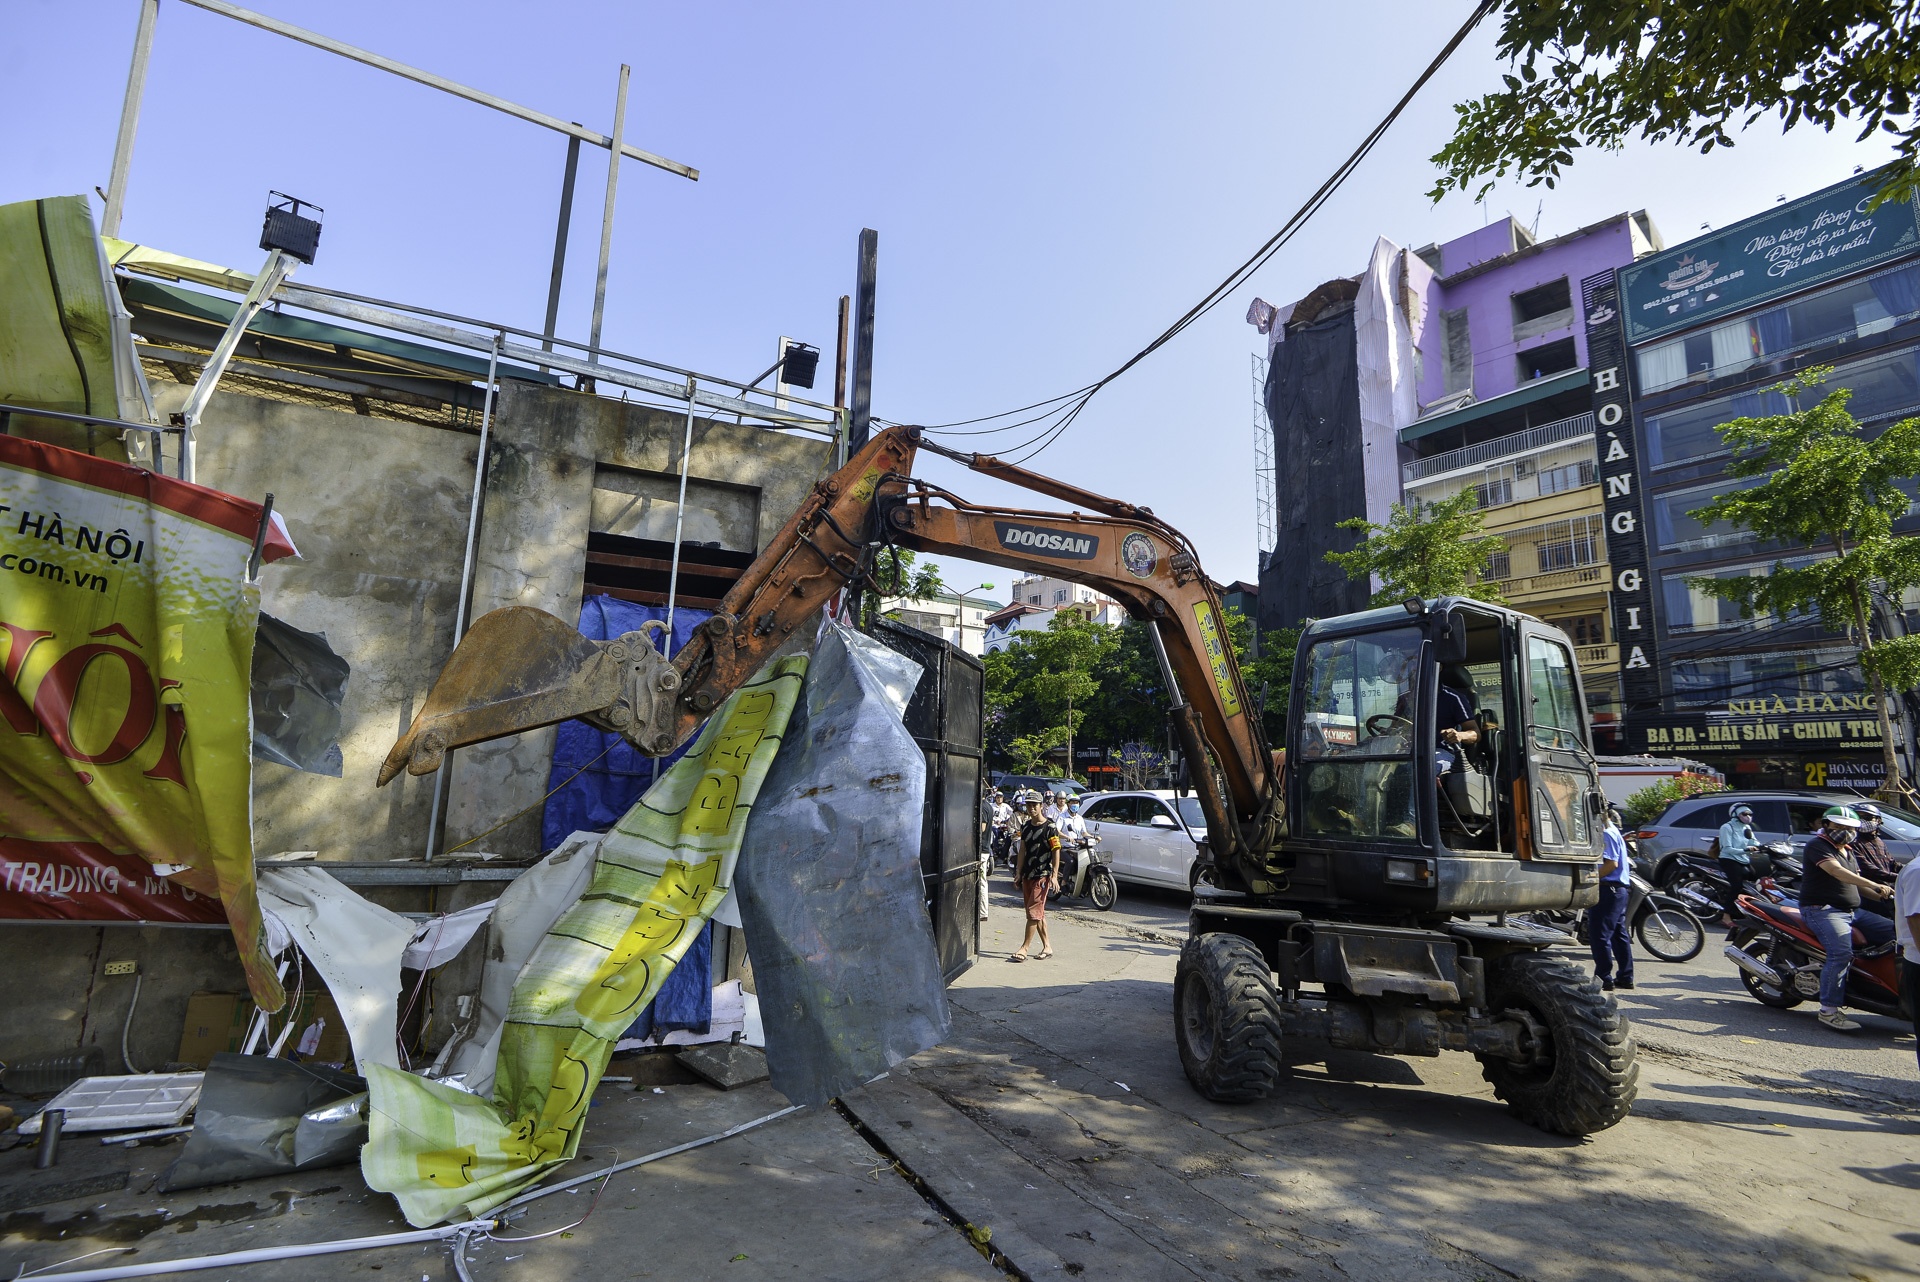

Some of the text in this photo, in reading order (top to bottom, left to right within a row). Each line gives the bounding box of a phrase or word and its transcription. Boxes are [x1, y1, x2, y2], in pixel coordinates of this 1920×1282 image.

[1744, 235, 1777, 255] Nhà
[1779, 226, 1808, 242] hàng
[1811, 209, 1851, 231] Hoàng
[1807, 231, 1828, 248] cấp
[1828, 228, 1847, 241] xa
[1848, 218, 1873, 233] hoa
[1668, 264, 1694, 281] HOÀNG
[1694, 259, 1708, 272] GIA
[1767, 258, 1799, 277] Giá
[1801, 249, 1826, 266] nhà
[1594, 366, 1650, 669] HOÀNG GIA
[18, 511, 144, 565] HÀ NỘI
[1005, 528, 1090, 554] DOOSAN
[1728, 692, 1877, 716] NHÀ HÀNG
[1646, 728, 1670, 743] BA
[1672, 727, 1697, 742] BA
[1707, 719, 1739, 741] HẢI
[1742, 718, 1780, 740] SẢN
[1793, 721, 1842, 739] CHIM
[1804, 761, 1887, 787] 2F HOÀNG GI
[1826, 777, 1853, 787] NGUYỄN
[1853, 778, 1877, 788] KHÁNH
[4, 861, 120, 895] TRADING
